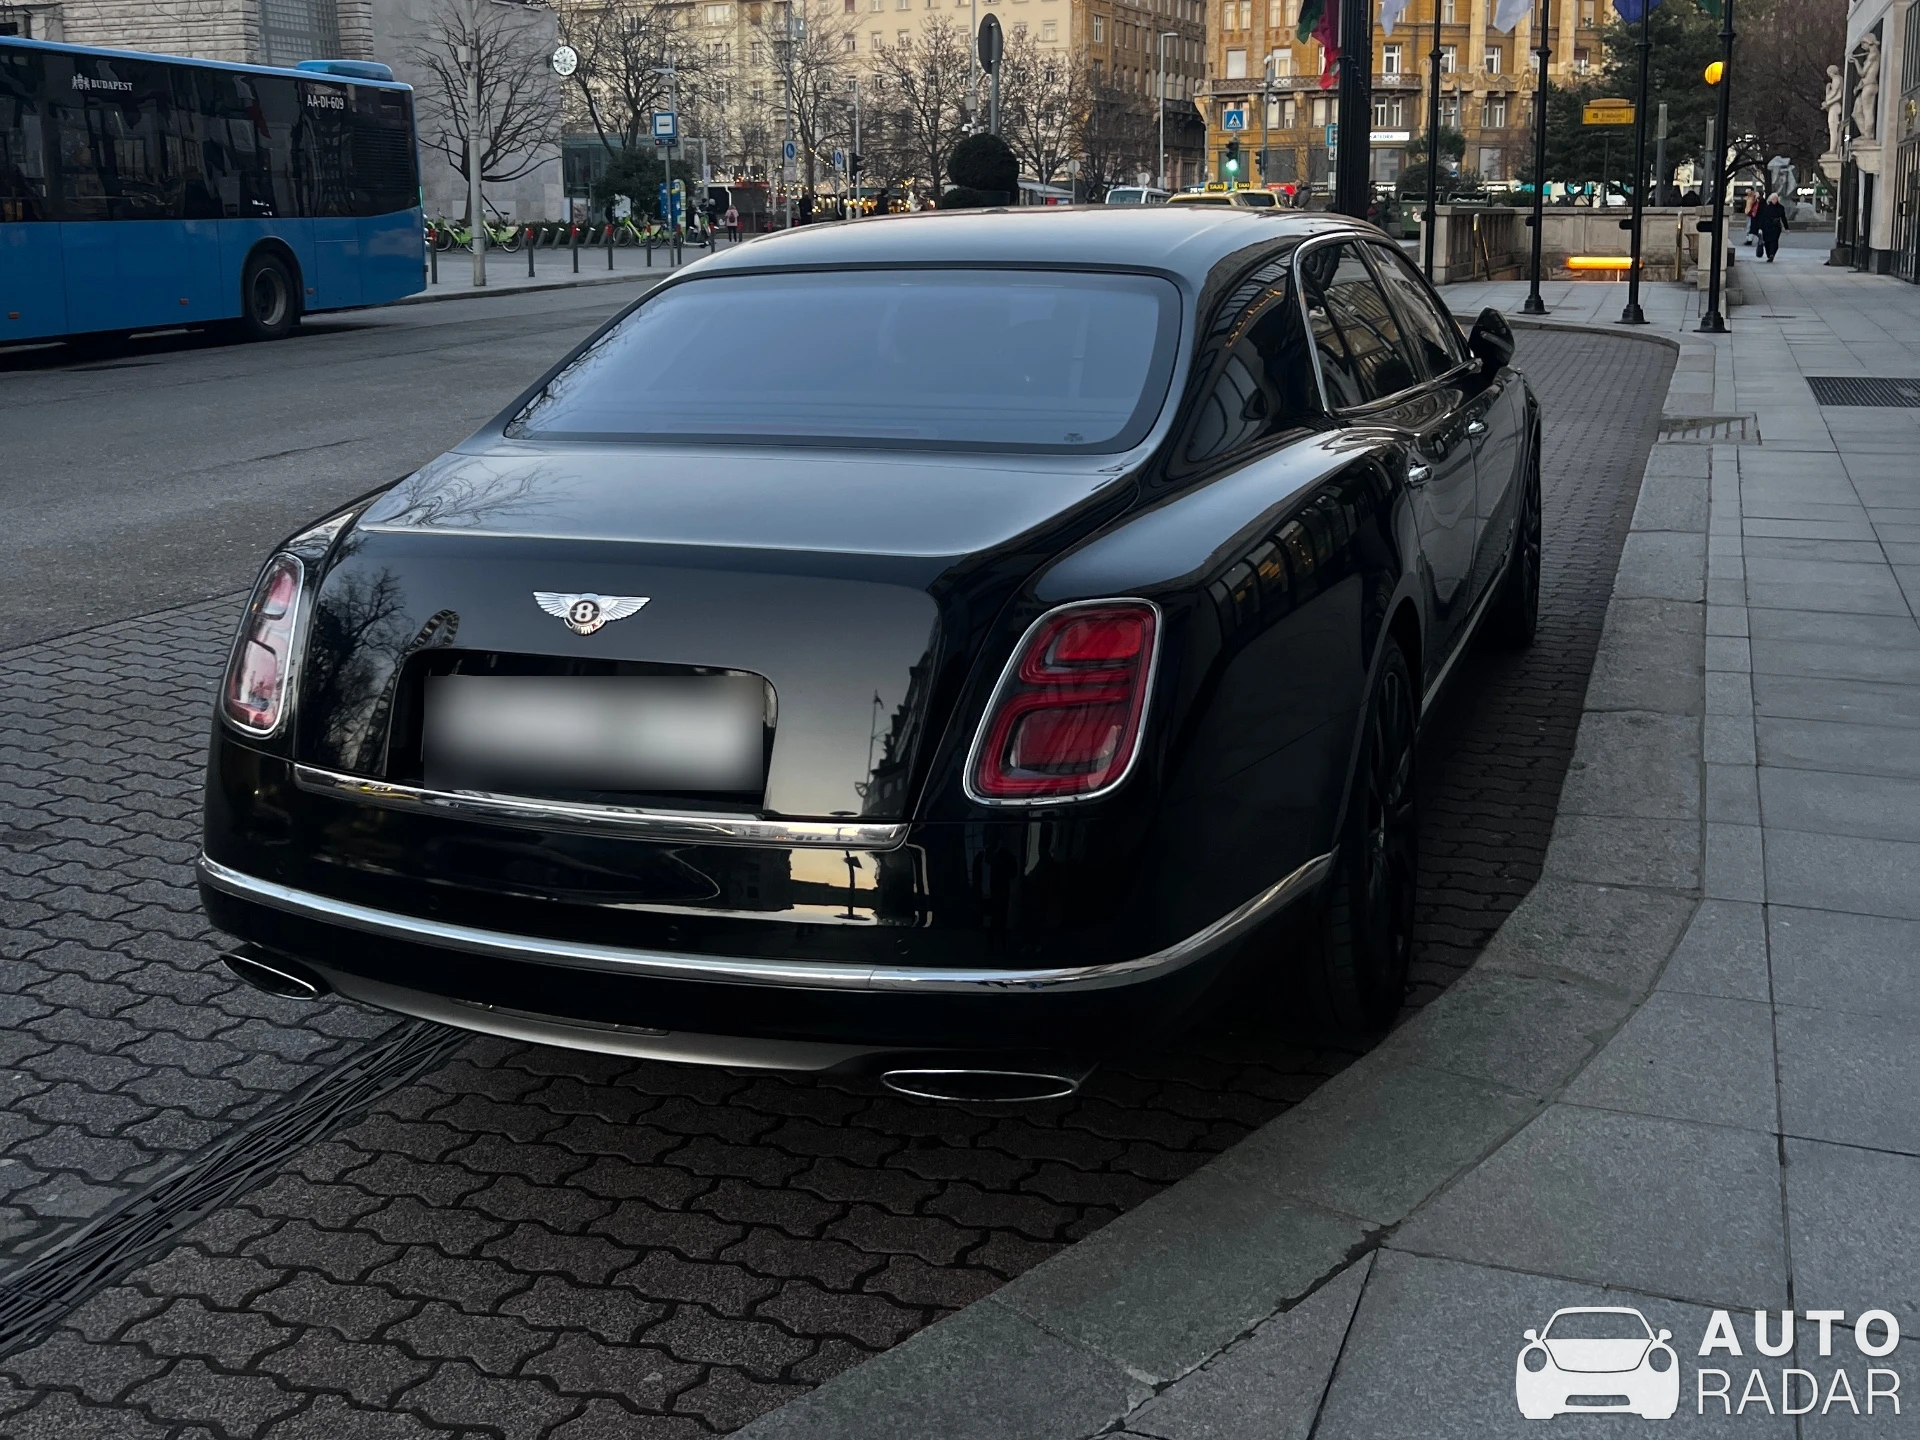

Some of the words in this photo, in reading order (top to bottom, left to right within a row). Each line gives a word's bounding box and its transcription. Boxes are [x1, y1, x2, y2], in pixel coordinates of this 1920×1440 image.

[90, 79, 133, 91] BUDAPEST
[307, 94, 344, 109] AA-DI-609
[574, 602, 594, 622] B
